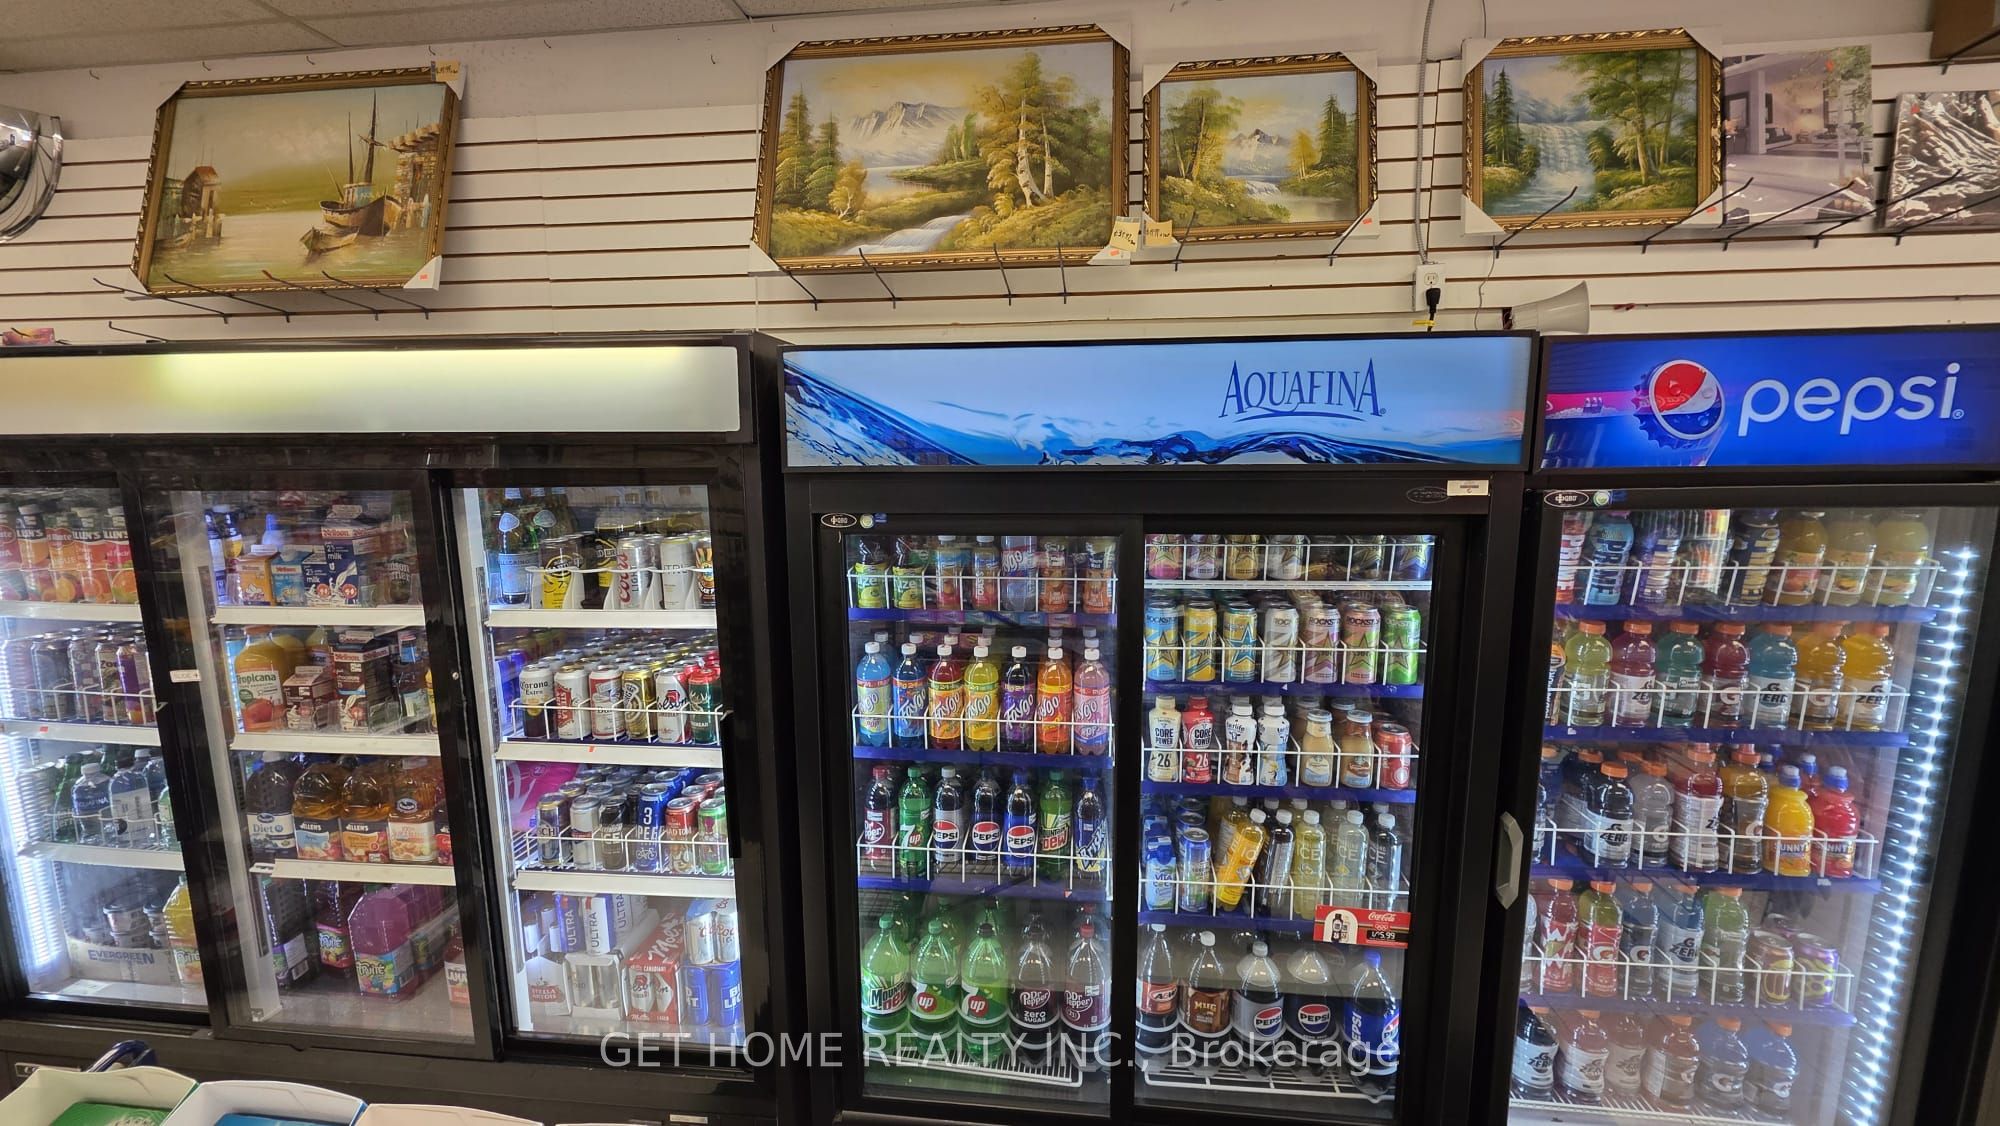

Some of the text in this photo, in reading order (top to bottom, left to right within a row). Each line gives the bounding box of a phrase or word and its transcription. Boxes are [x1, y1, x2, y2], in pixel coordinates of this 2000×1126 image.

[1219, 358, 1382, 418] AQUAFINA
[1738, 362, 1961, 438] pepsi
[1590, 538, 1628, 595] PRIME
[898, 690, 927, 723] Faygo
[932, 692, 961, 728] Faygo
[1004, 694, 1034, 729] Faygo
[1154, 728, 1174, 738] CORE
[1194, 728, 1212, 739] CORE
[1194, 738, 1211, 747] POWER
[1157, 753, 1171, 767] 26
[1195, 753, 1209, 767] 26
[643, 807, 653, 825] 3
[253, 823, 274, 833] Diet
[618, 893, 627, 930] ULTRA
[1368, 911, 1397, 923] Coca-Cola
[569, 909, 578, 947] ULTRA
[591, 911, 600, 948] ULTRA
[88, 949, 155, 965] EVERGREEN
[918, 996, 935, 1009] up
[970, 999, 986, 1013] up
[1194, 1001, 1216, 1010] MUG
[1256, 1015, 1282, 1026] PEPSI
[1300, 1012, 1330, 1023] PEPSI
